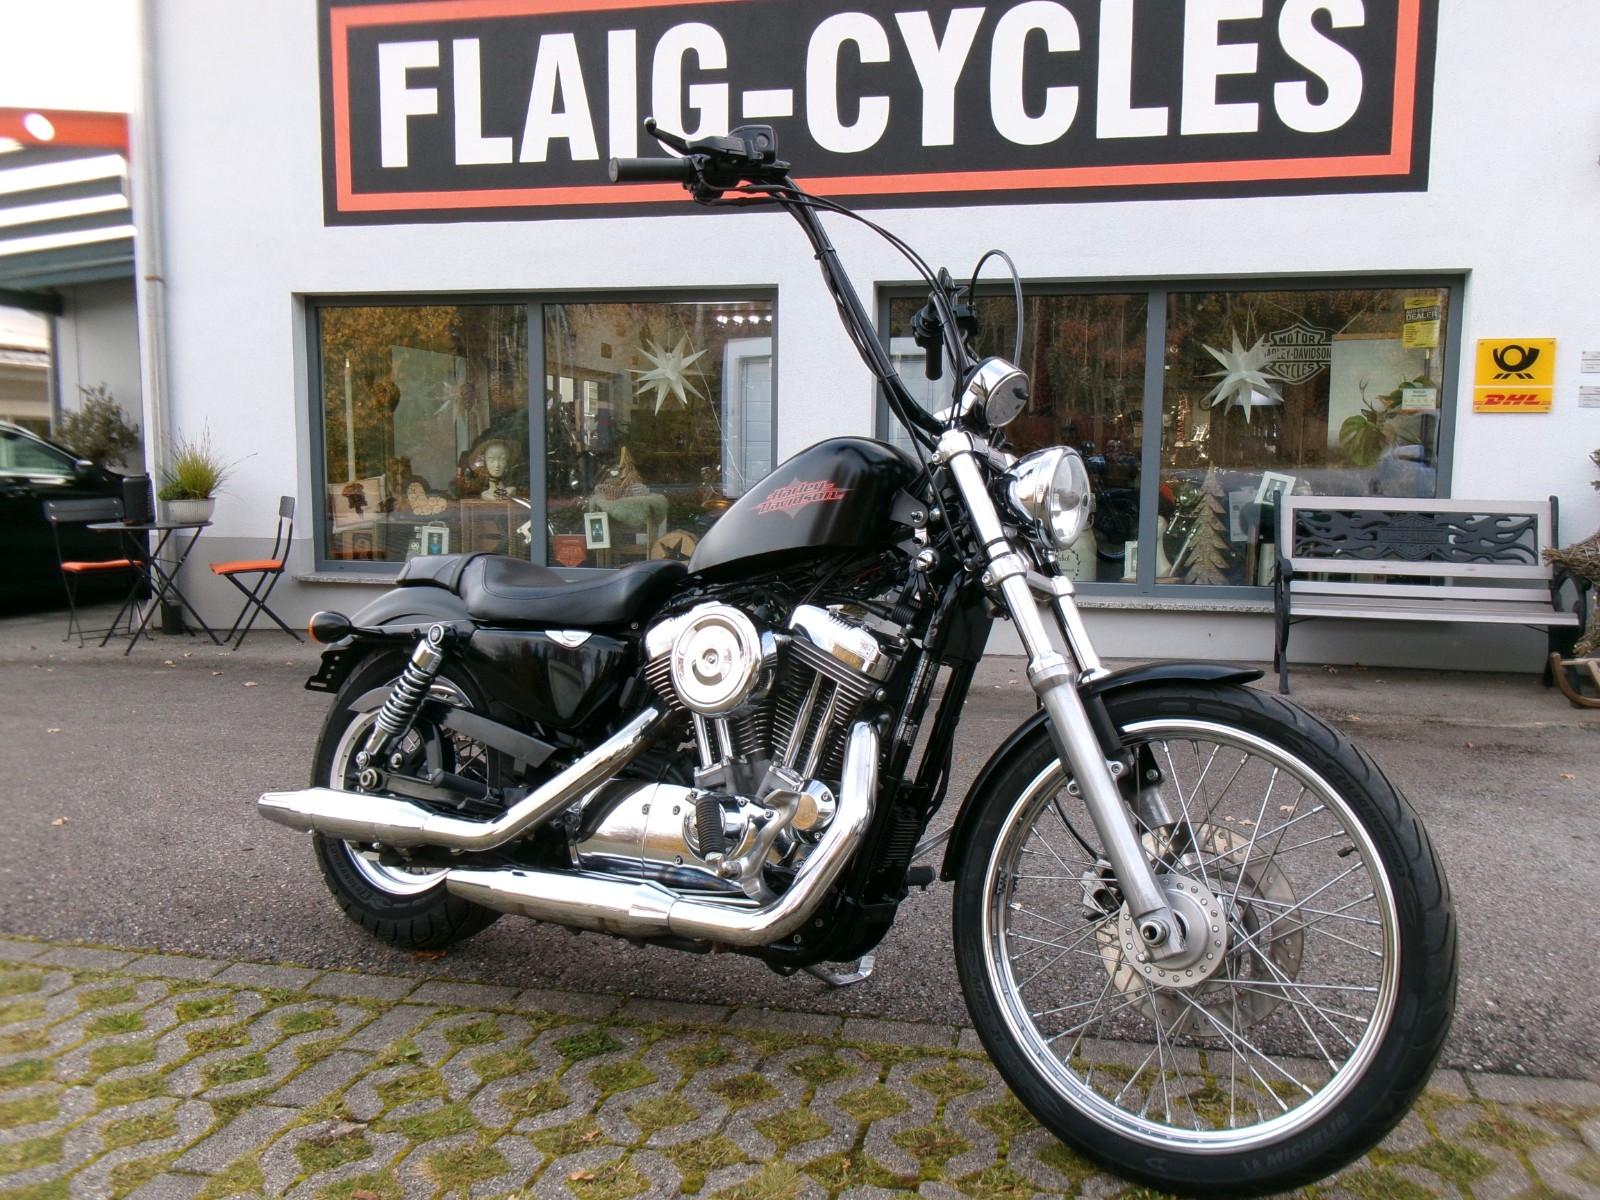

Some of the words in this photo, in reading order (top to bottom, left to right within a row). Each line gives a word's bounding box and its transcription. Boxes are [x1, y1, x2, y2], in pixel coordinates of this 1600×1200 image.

[378, 0, 1365, 168] FLAIG-CYCLES
[1278, 330, 1316, 345] MOTOR
[1278, 362, 1315, 379] CYCLES
[1484, 394, 1540, 406] DHL
